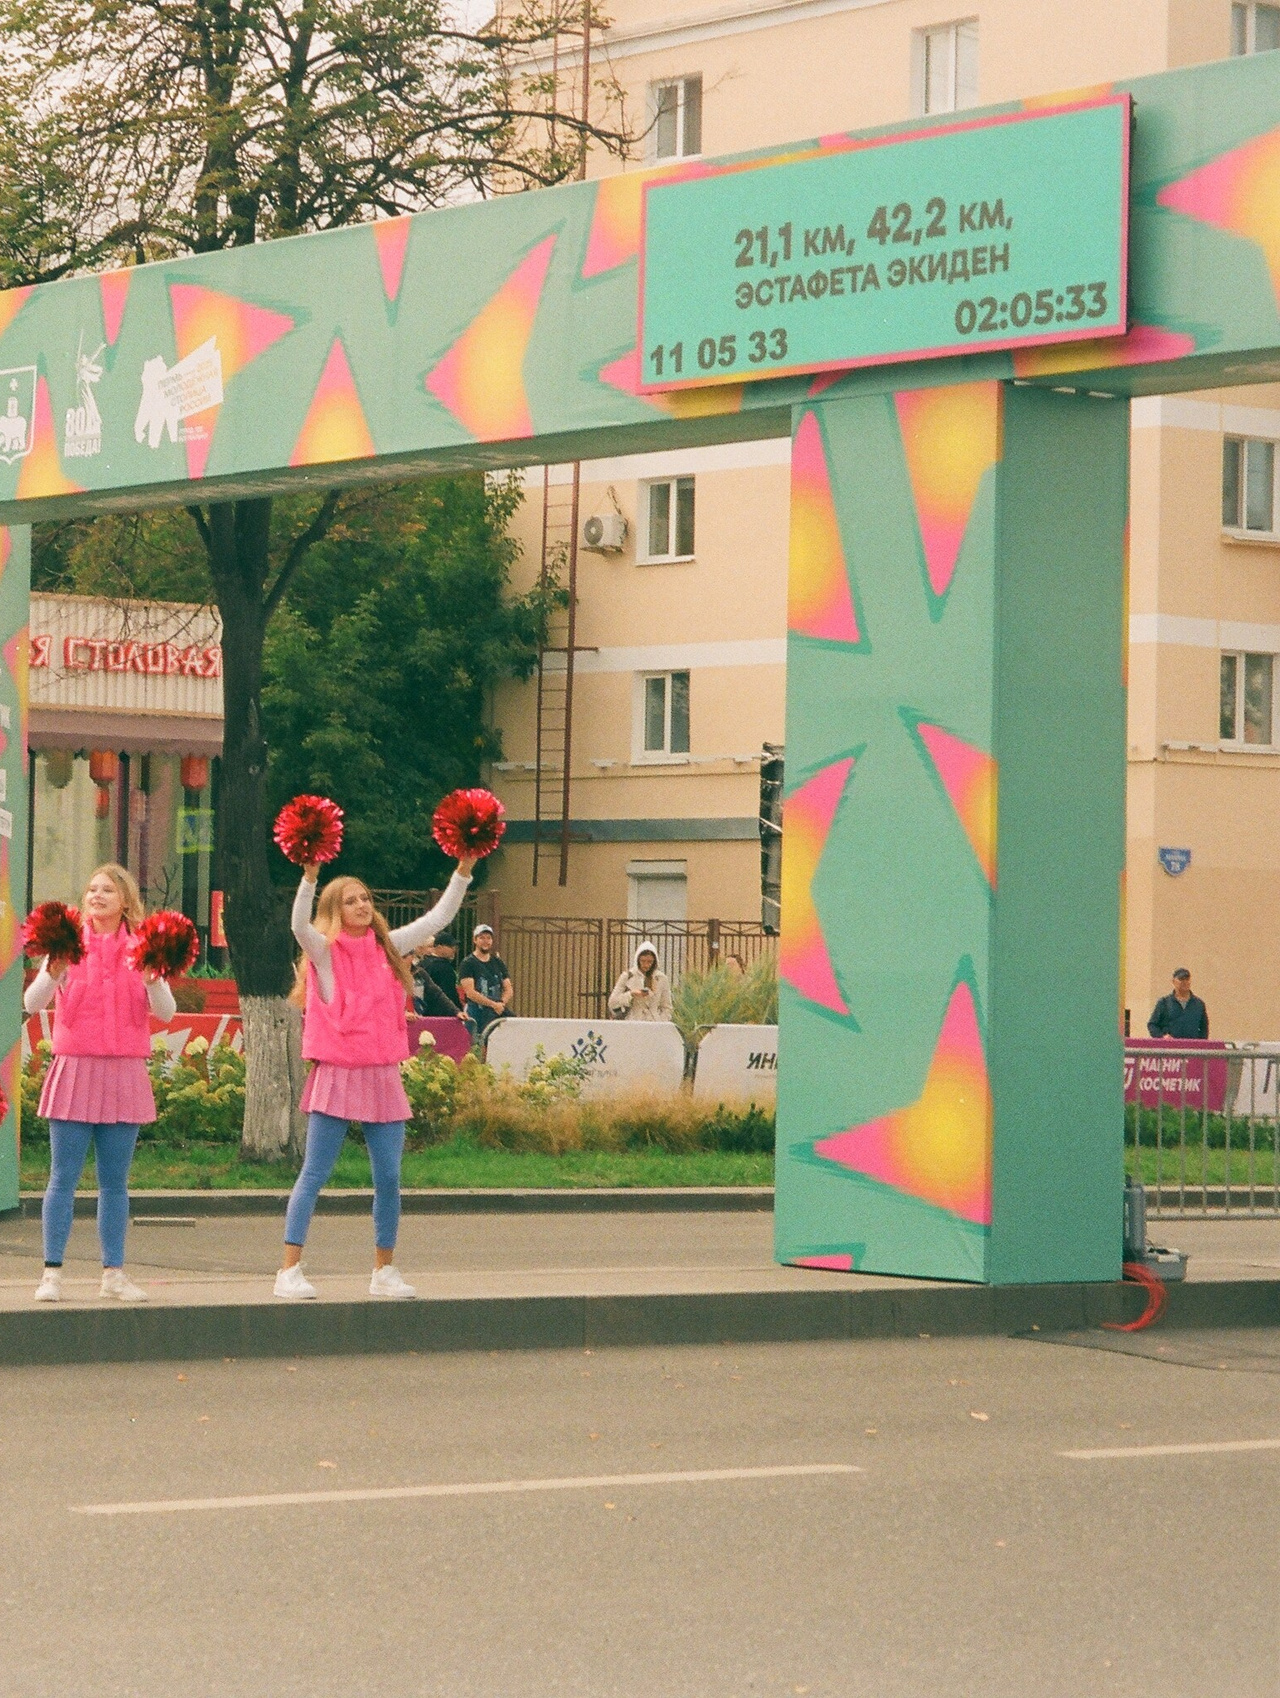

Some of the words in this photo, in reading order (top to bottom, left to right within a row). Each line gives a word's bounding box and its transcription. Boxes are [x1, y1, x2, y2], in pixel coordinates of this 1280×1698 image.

[735, 221, 793, 268] 21,1
[867, 197, 946, 246] 42,2
[735, 263, 881, 309] ЭСТАФЕТА
[887, 242, 1010, 288] ЭКИДЕН
[954, 282, 1107, 335] 02:05:33
[650, 342, 683, 375] 11
[697, 334, 737, 370] 05
[748, 328, 788, 364] 33
[29, 635, 52, 667] Я
[64, 636, 221, 677] СТОЛОВАЯ
[746, 1052, 778, 1069] ИН
